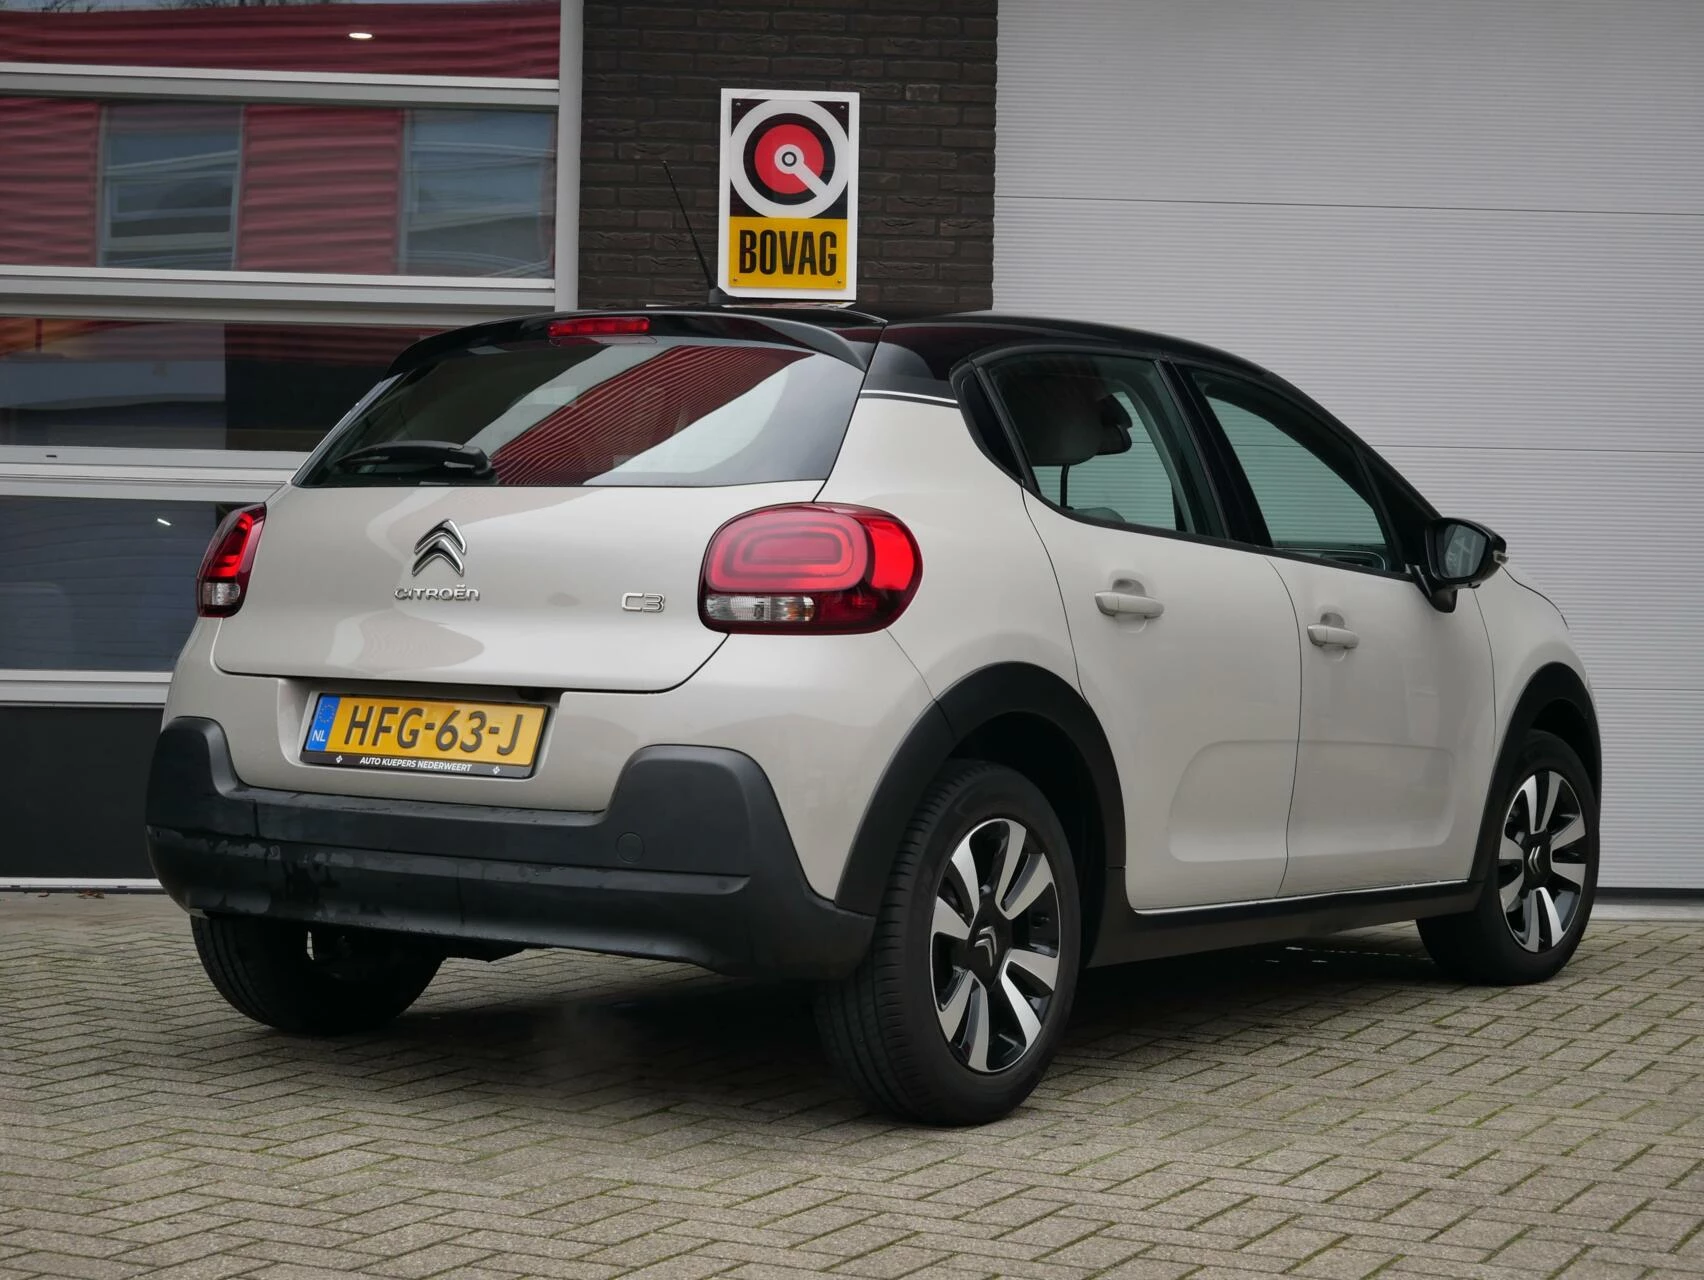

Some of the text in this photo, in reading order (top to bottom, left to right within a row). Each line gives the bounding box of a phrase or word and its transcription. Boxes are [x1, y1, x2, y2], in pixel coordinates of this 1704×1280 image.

[739, 229, 837, 276] BOVAG
[394, 584, 481, 601] CITROËN
[621, 592, 665, 613] C3
[312, 729, 326, 743] NL
[344, 705, 523, 756] HFG-63-J
[360, 756, 472, 772] AUTO KUEPERS NEDERWEERT
